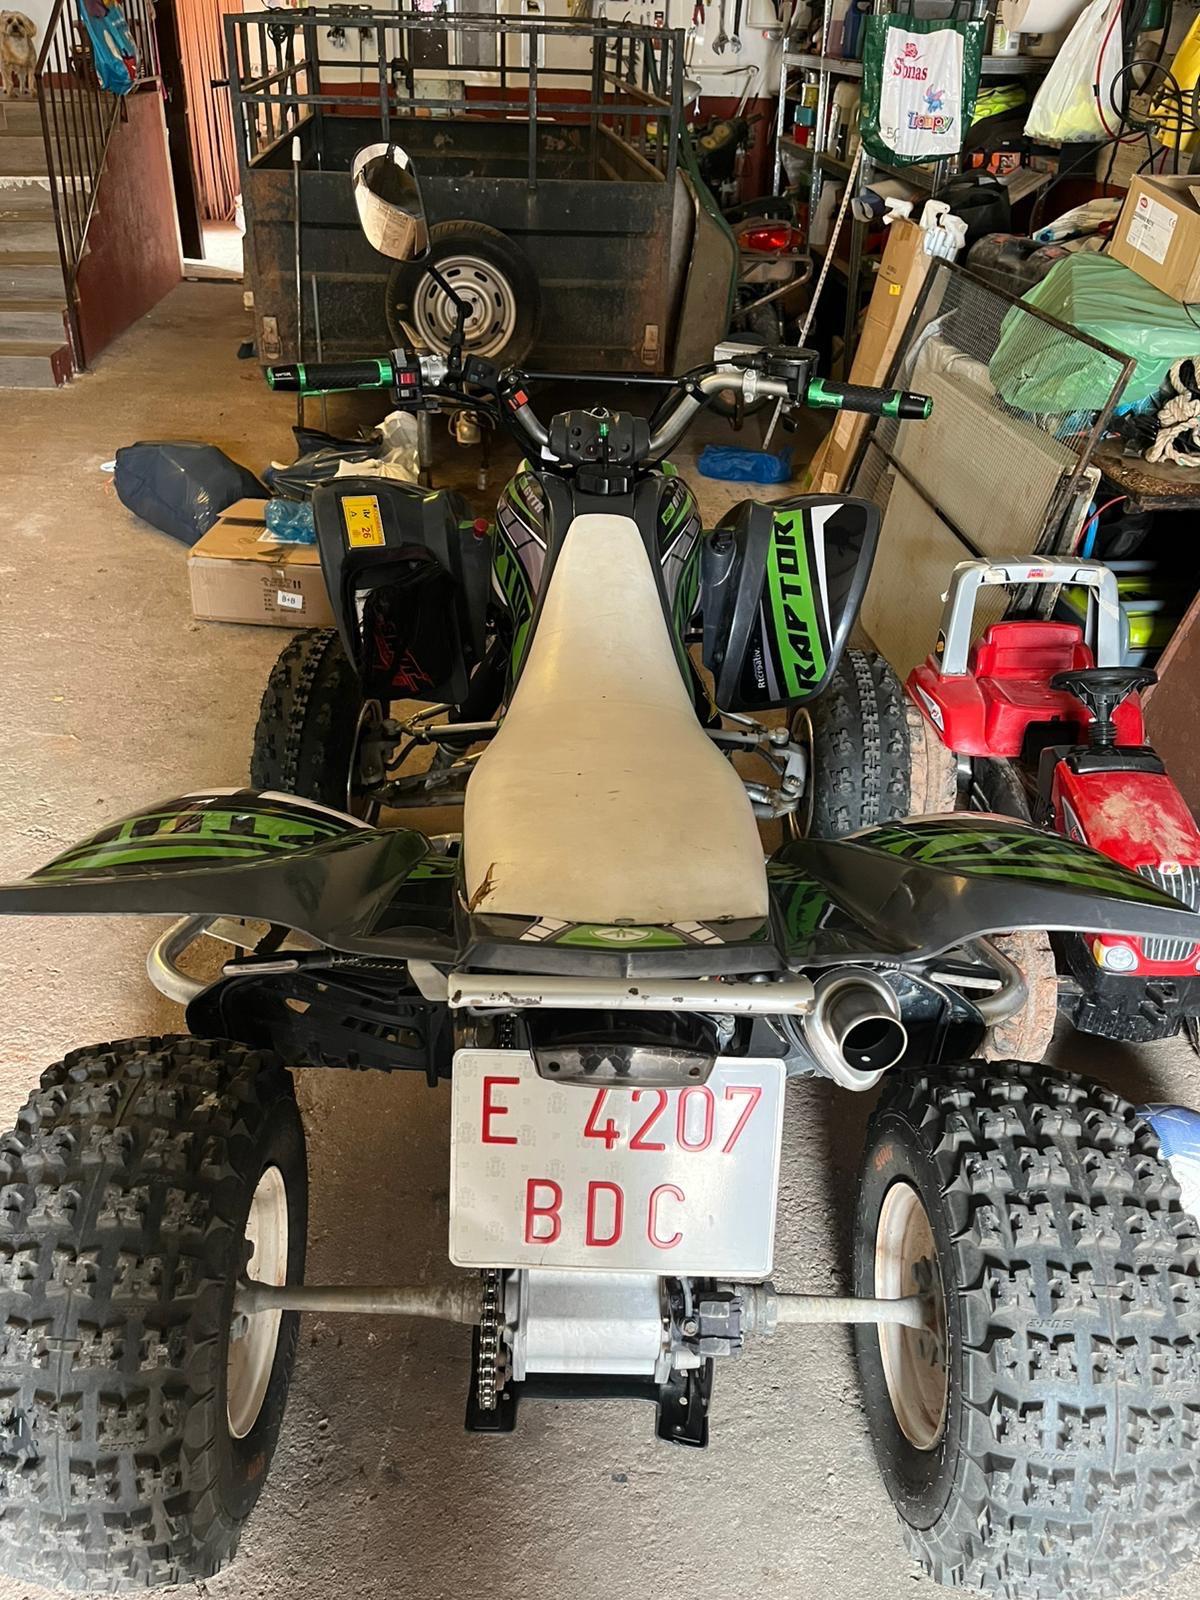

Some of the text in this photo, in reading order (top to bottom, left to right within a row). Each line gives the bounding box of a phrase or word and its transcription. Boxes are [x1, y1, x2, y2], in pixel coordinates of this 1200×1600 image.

[773, 519, 821, 691] RAPTOR
[481, 1075, 763, 1154] E 4207
[524, 1177, 686, 1250] BDC
